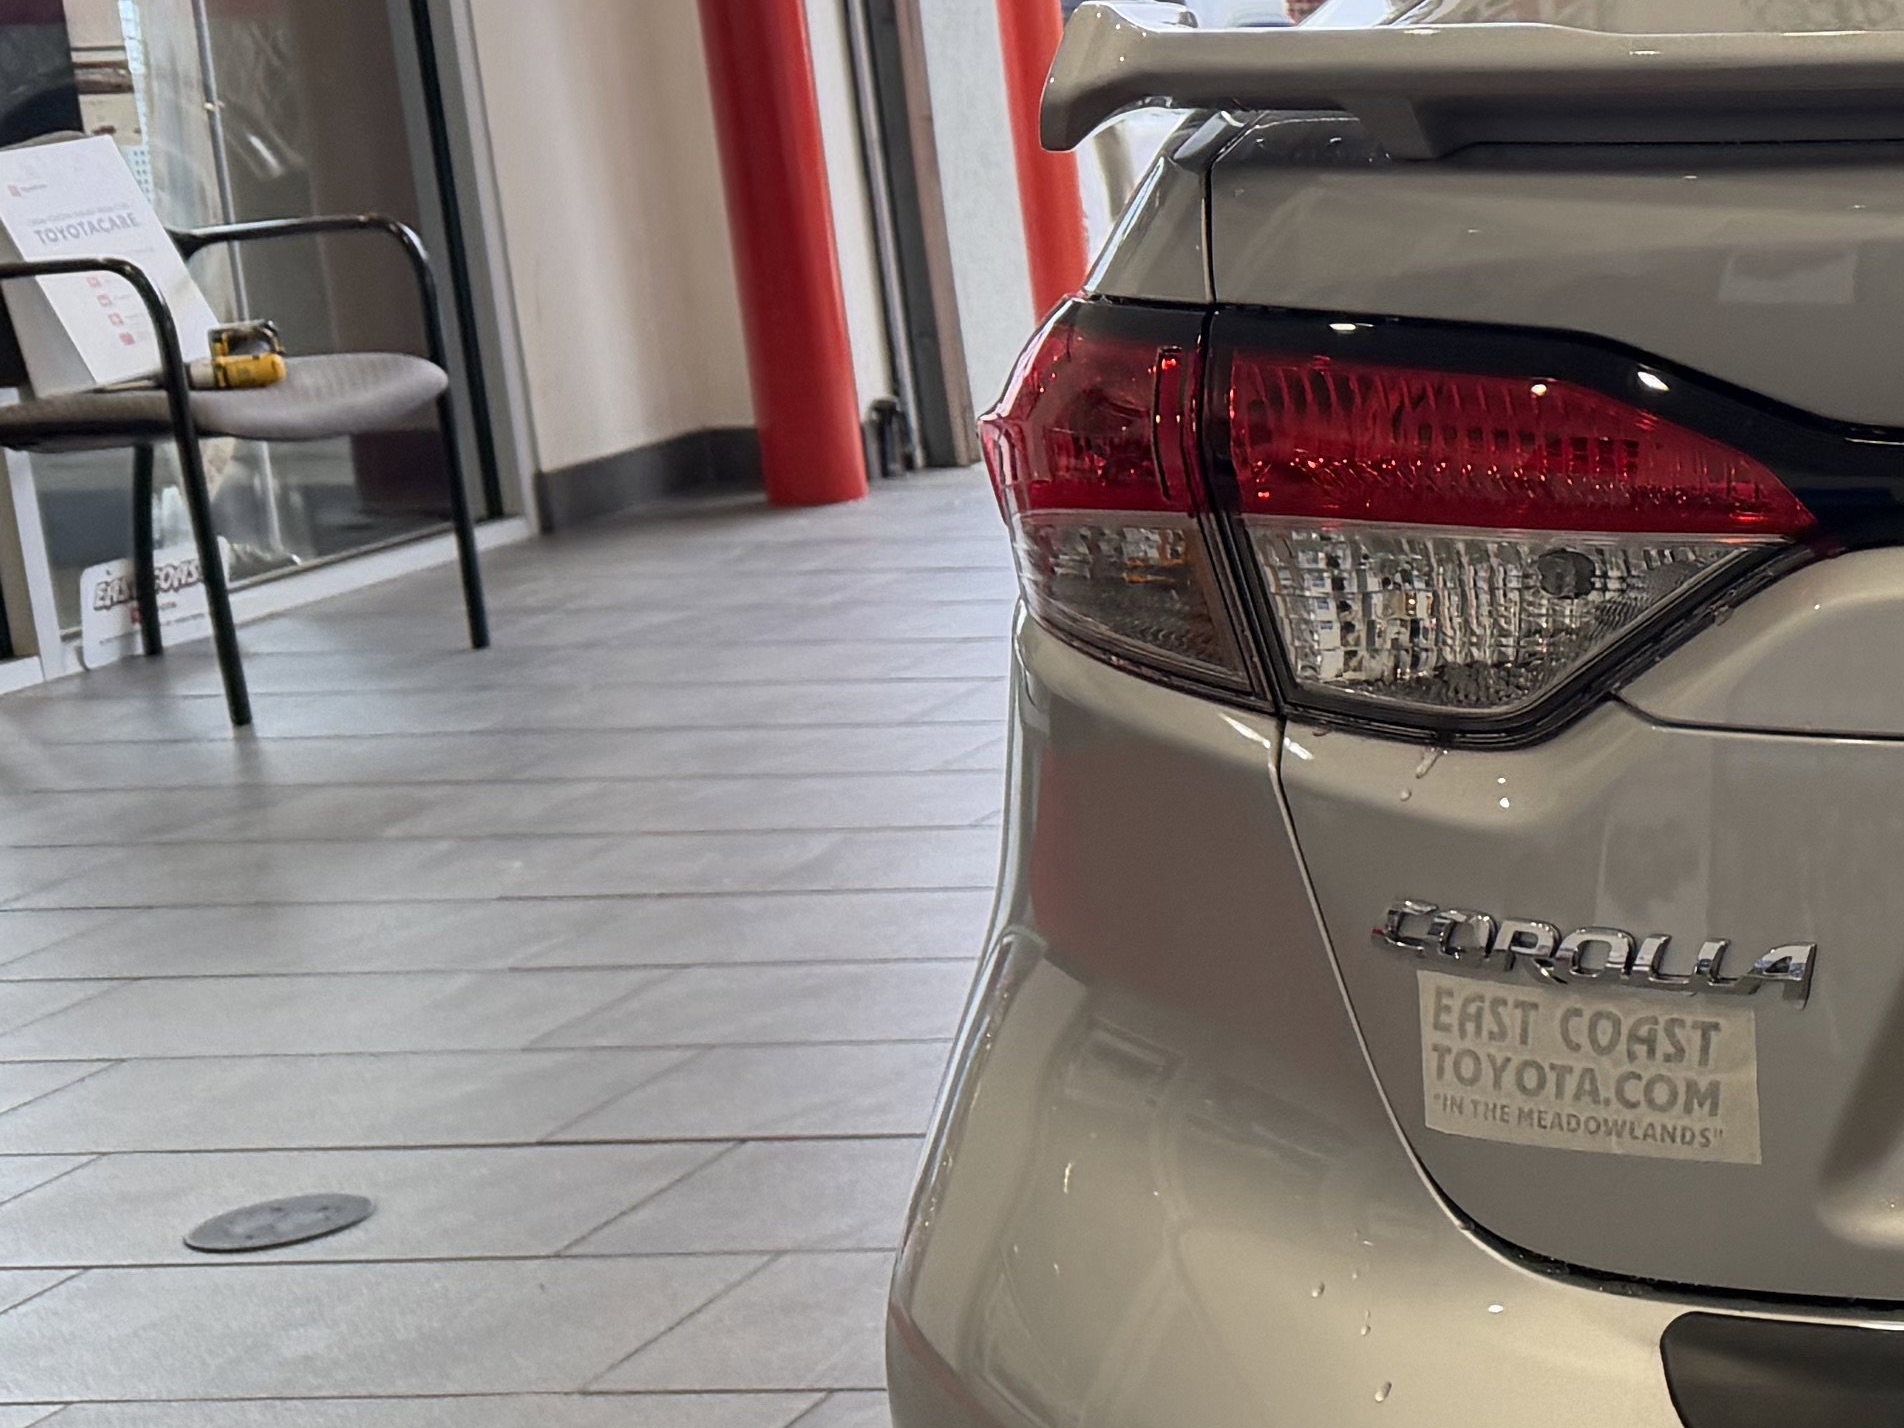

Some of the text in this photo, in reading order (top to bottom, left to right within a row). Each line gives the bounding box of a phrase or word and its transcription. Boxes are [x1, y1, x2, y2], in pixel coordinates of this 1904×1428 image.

[33, 212, 141, 246] TOYOTACARE
[1373, 899, 1818, 1009] COROLLA
[1432, 986, 1722, 1066] EAST COAST
[1431, 1043, 1721, 1117] TOYOTA.COM
[1471, 1098, 1510, 1123] THE
